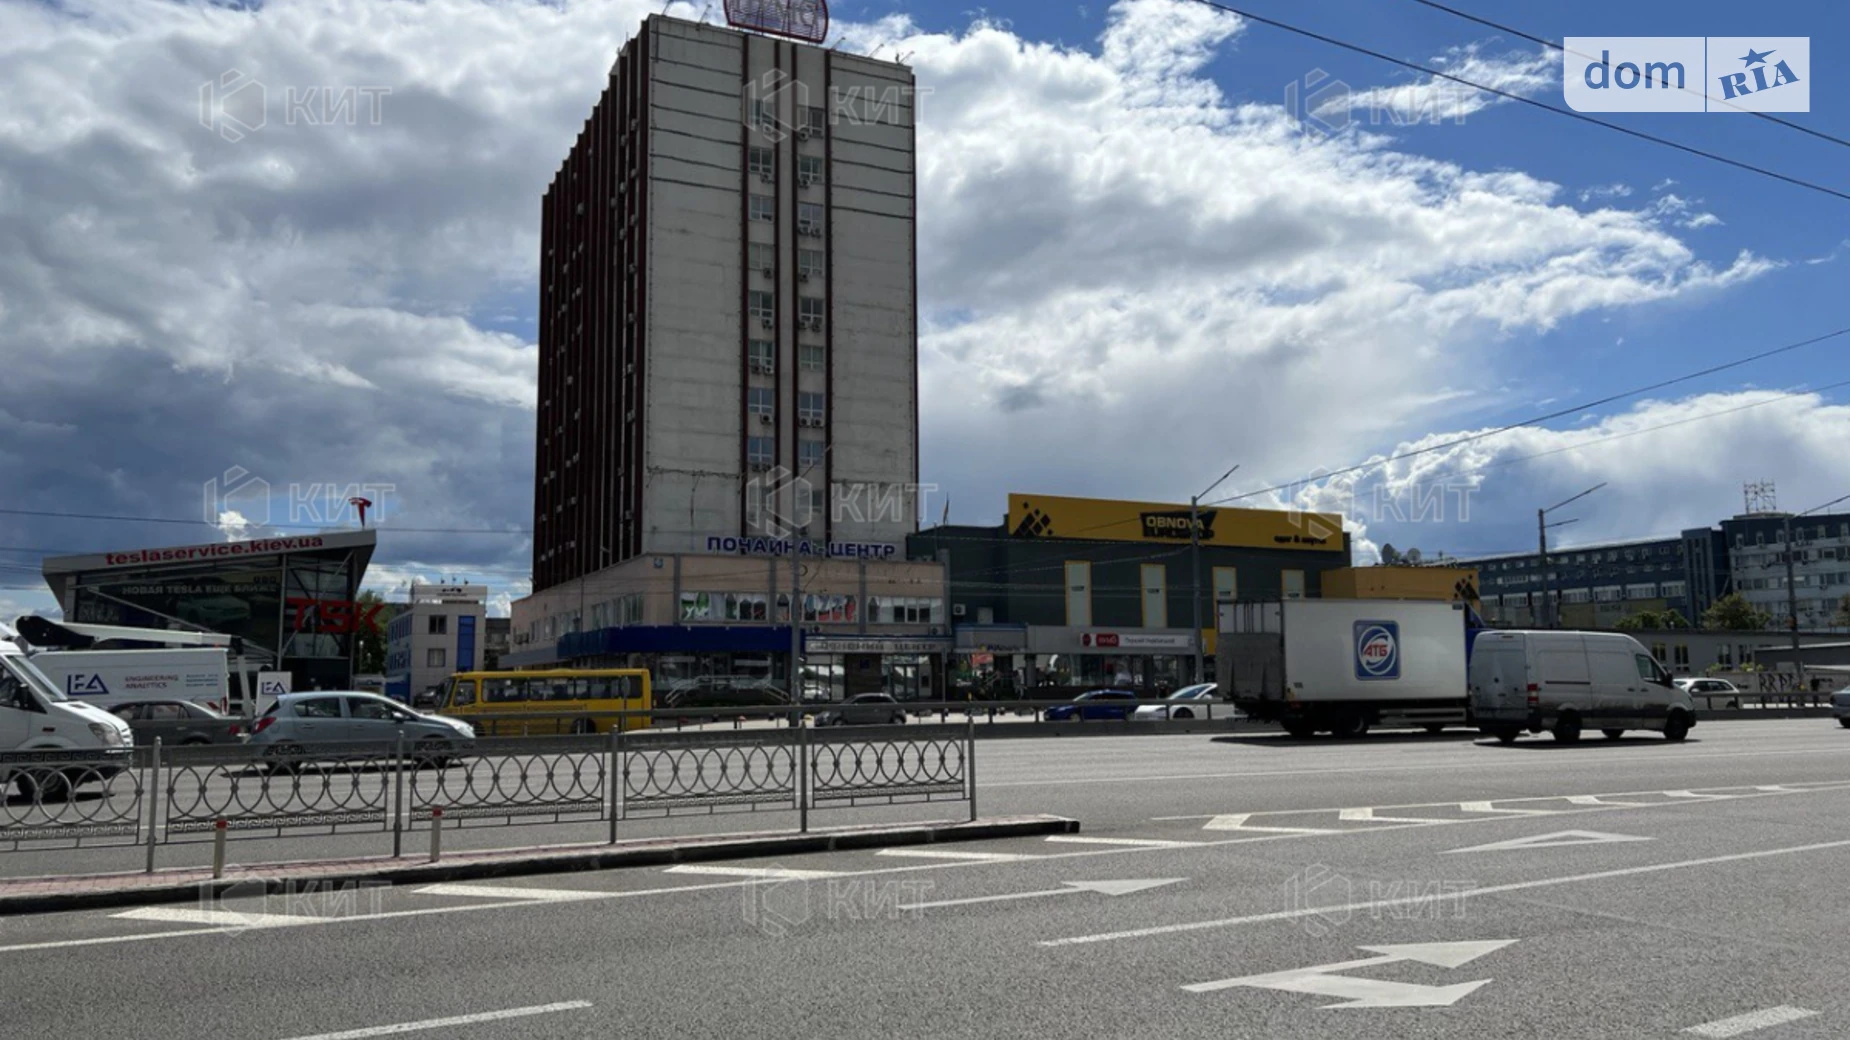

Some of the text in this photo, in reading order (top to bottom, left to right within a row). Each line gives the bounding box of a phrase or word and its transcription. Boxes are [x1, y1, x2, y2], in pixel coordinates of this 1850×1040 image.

[1146, 516, 1204, 530] OBNOVA
[105, 535, 324, 566] teslaservice.kiev.ua
[122, 585, 163, 595] НОВАЯ
[166, 584, 202, 594] TESLA
[286, 597, 385, 635] TSK
